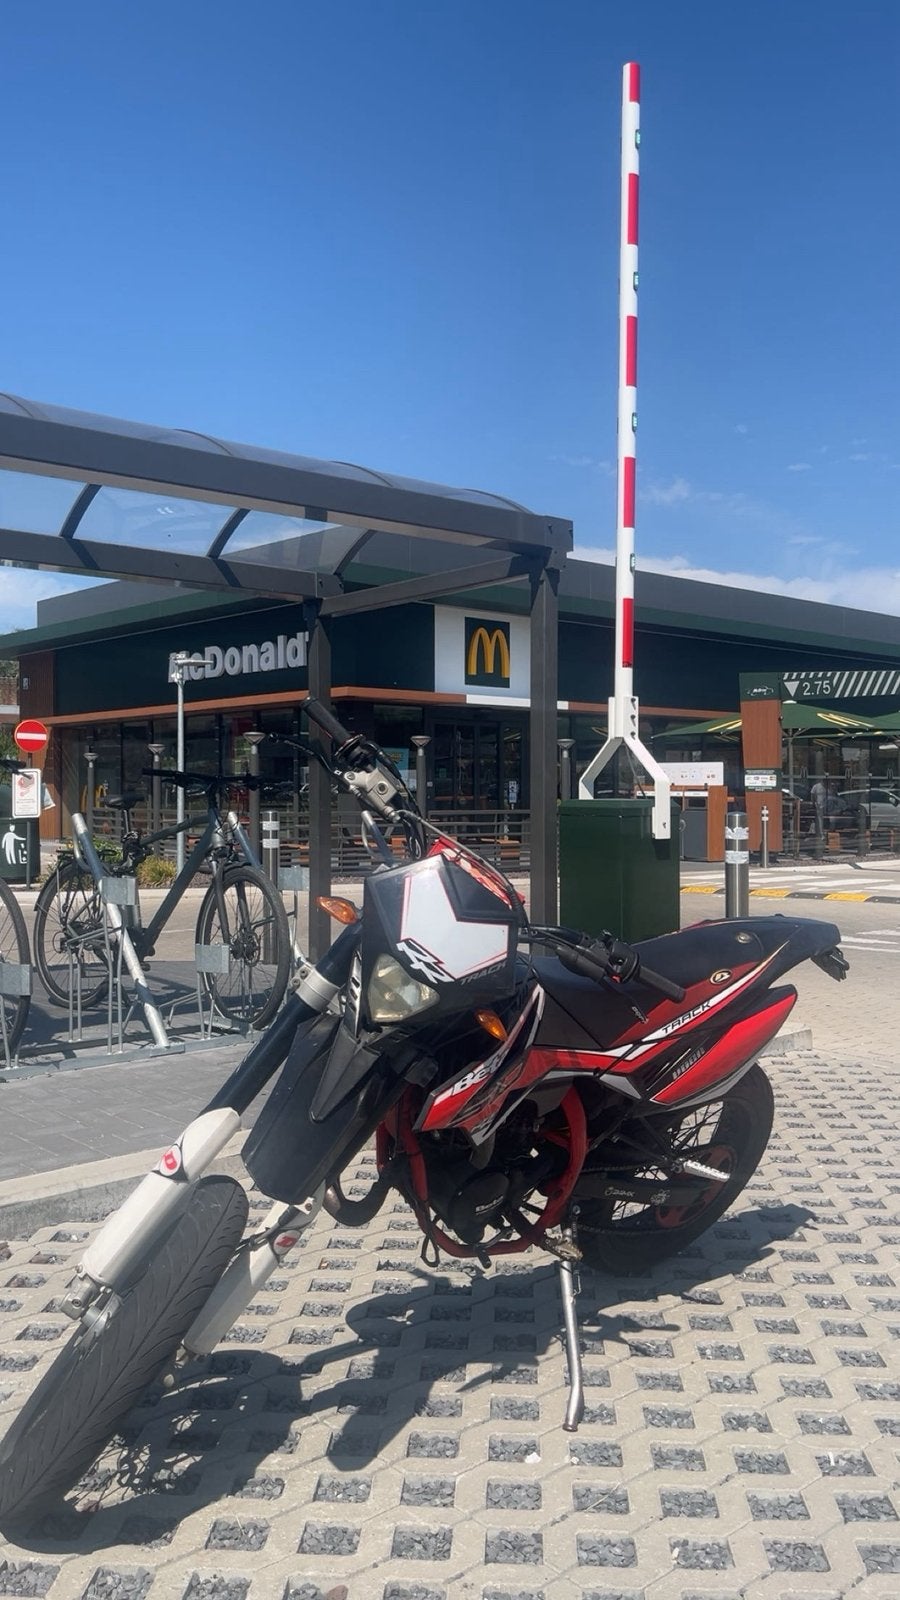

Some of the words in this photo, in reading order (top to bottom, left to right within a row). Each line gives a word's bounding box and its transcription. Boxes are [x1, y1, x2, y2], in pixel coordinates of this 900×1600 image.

[168, 631, 309, 682] McDonald'
[802, 681, 831, 696] 2.75
[661, 999, 711, 1033] TRACK
